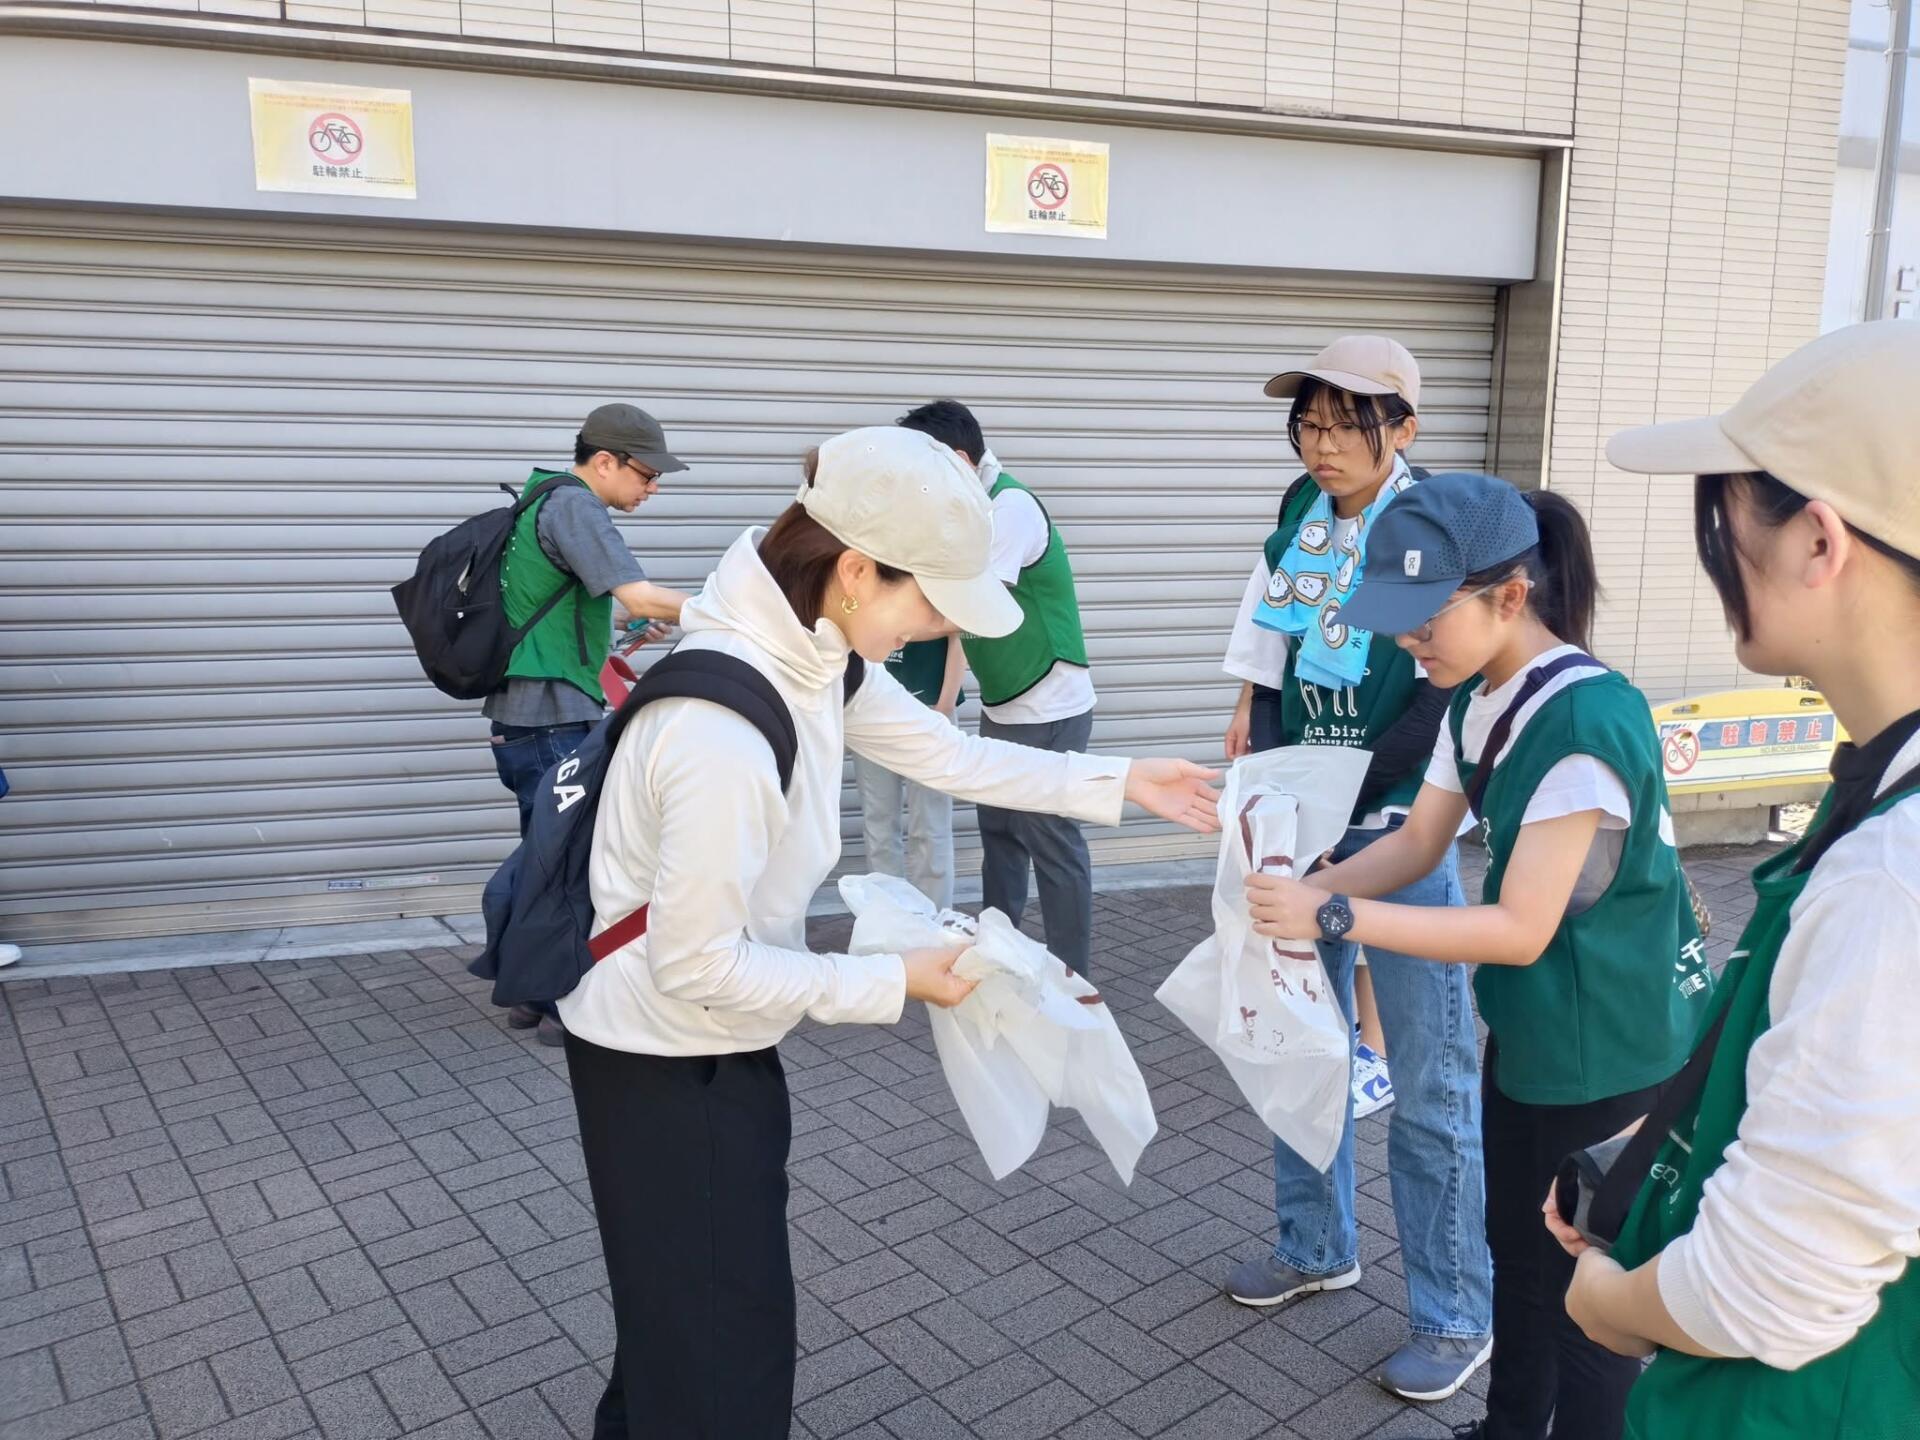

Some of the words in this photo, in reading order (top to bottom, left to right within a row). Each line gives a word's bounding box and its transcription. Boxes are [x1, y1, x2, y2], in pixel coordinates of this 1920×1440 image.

[312, 165, 363, 179] 駐輪禁止
[1028, 209, 1067, 221] 駐輪禁止
[1720, 719, 1822, 747] 駐輪禁止
[553, 749, 586, 813] GA
